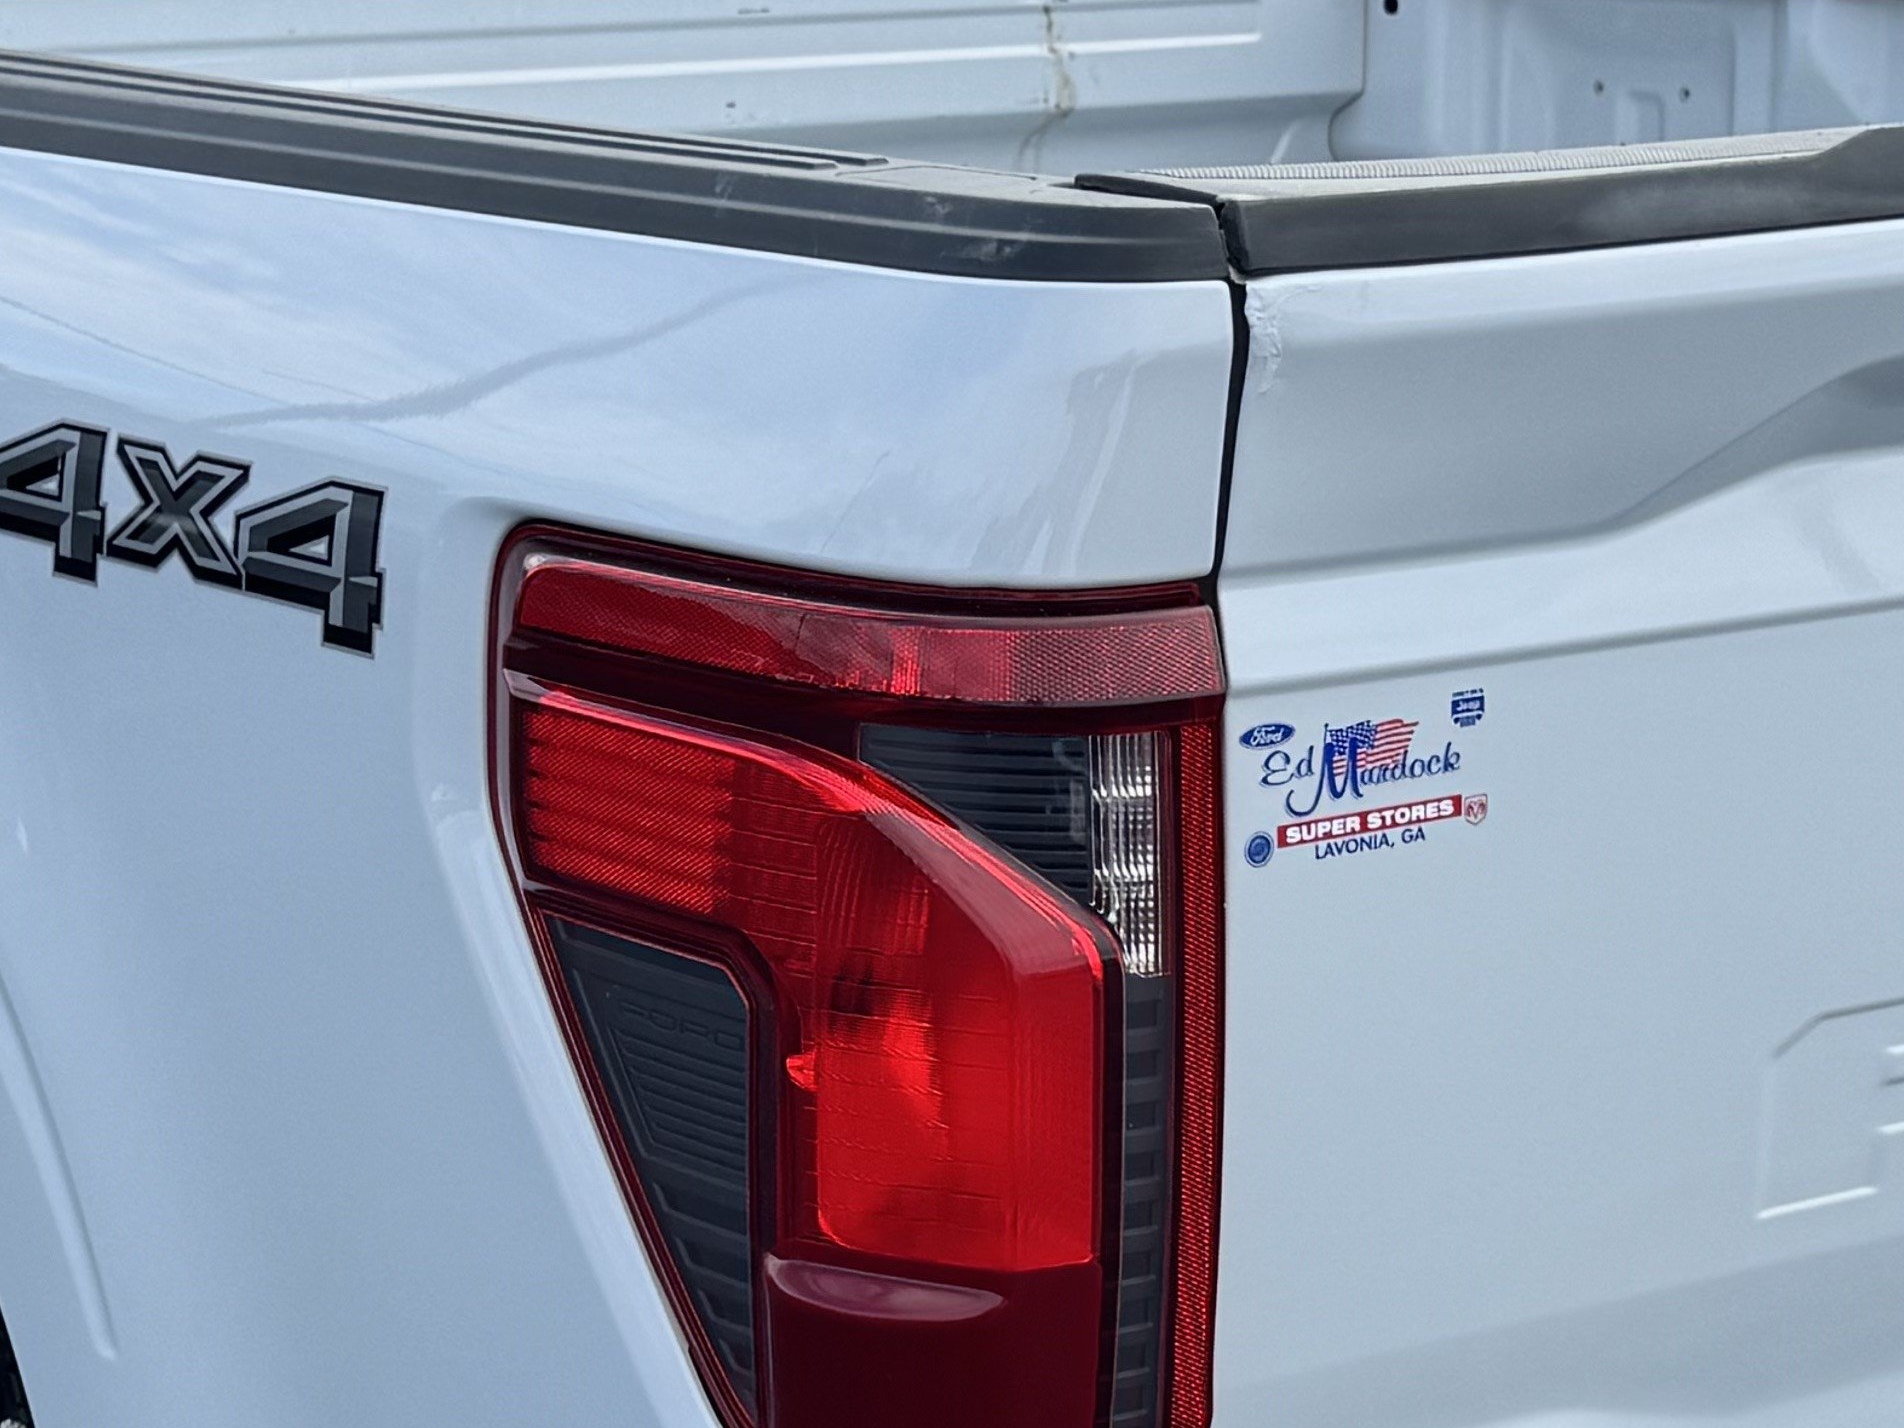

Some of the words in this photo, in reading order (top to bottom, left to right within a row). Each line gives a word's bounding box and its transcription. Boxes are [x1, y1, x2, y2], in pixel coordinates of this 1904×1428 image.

[1259, 745, 1315, 788] Ed
[1285, 740, 1461, 818] Murdock
[1285, 819, 1361, 845] SUPER
[1366, 799, 1455, 830] STORES
[1315, 834, 1395, 860] LAVONIA,
[1401, 827, 1426, 845] GA
